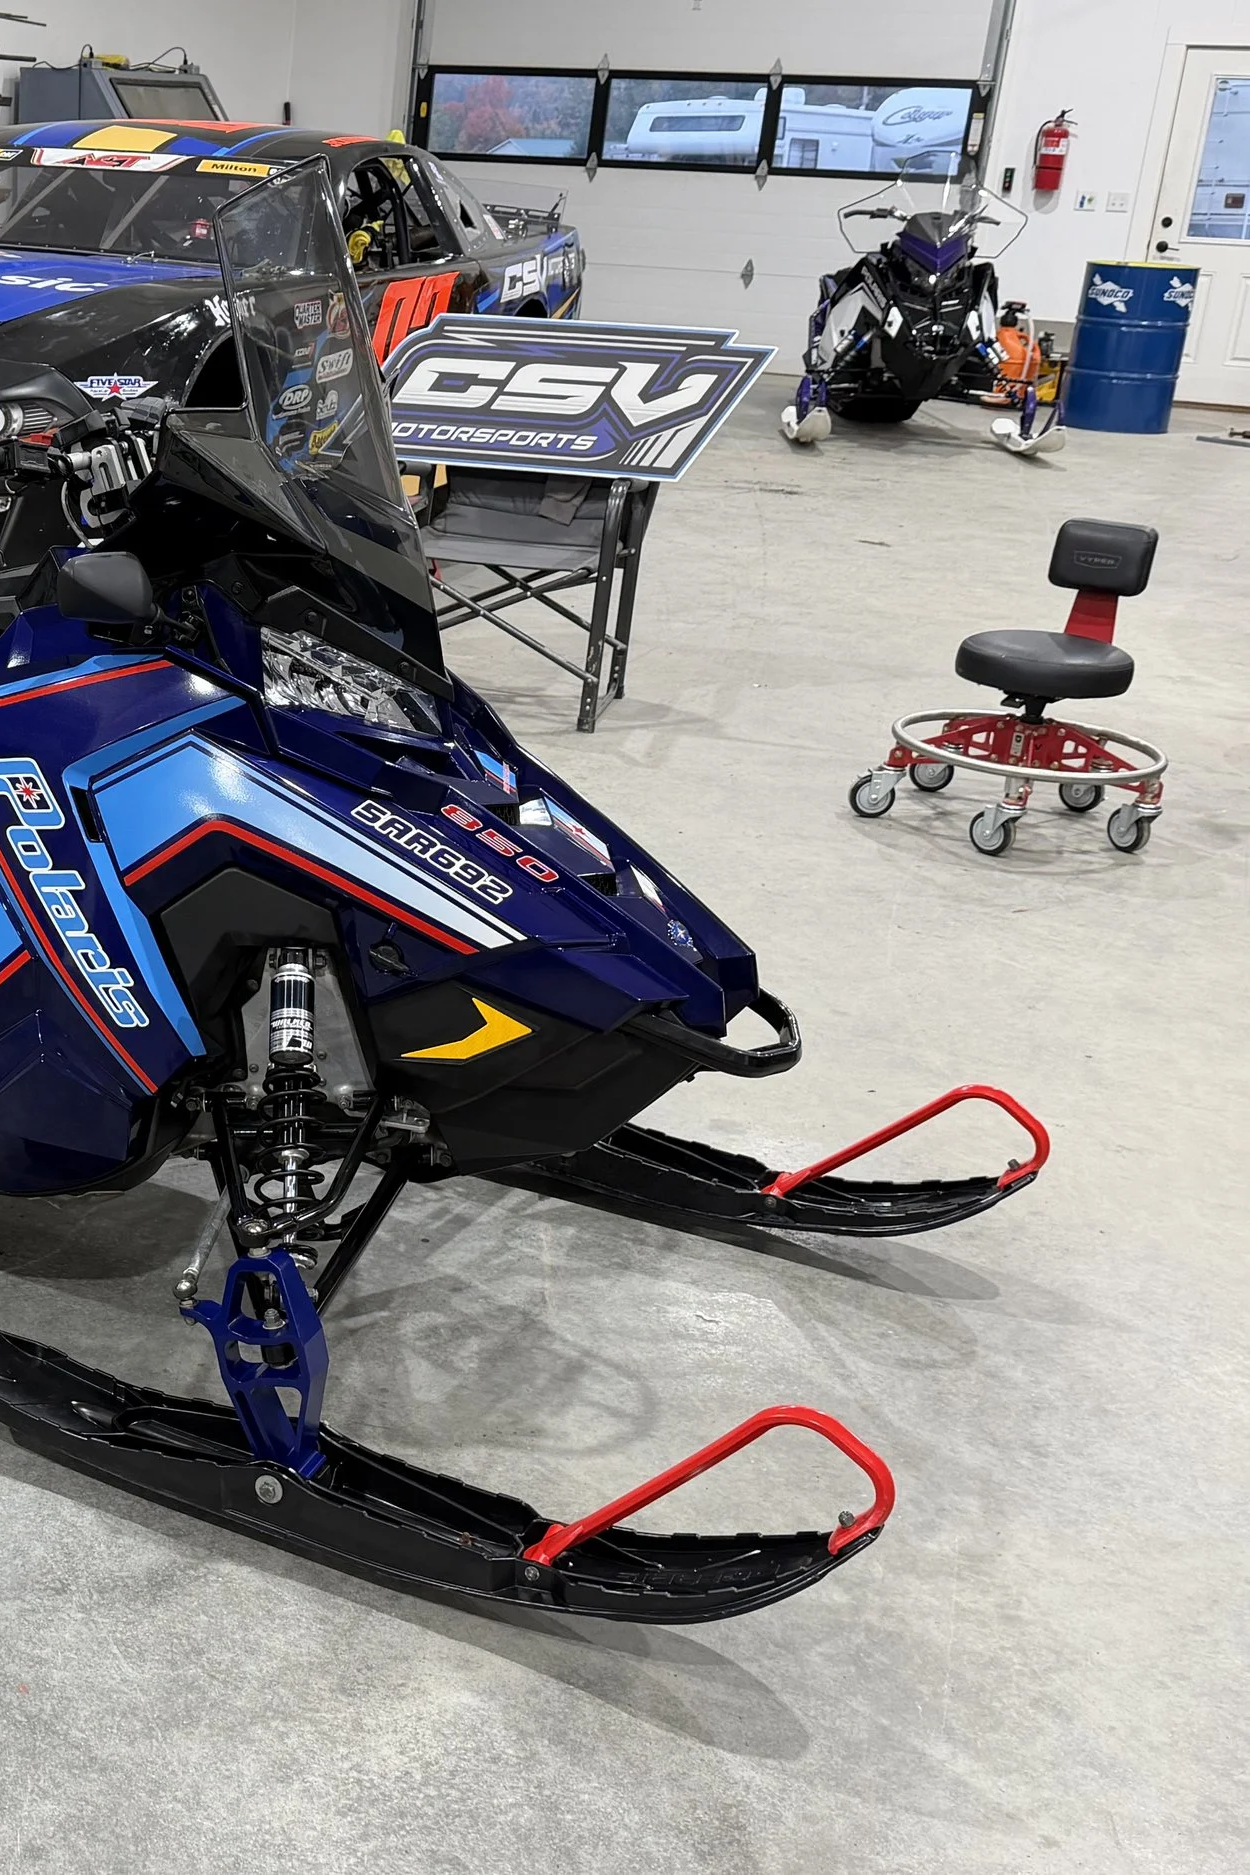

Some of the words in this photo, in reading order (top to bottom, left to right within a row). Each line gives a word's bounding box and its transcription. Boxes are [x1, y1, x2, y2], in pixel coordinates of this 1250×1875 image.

[211, 162, 257, 173] Milton
[1088, 286, 1132, 299] SUNOCO
[90, 379, 113, 388] FIVE
[116, 379, 141, 388] STAR
[283, 389, 309, 406] DRP
[392, 357, 718, 428] CSV
[391, 421, 598, 450] OTORSPORTS
[440, 804, 560, 883] 850
